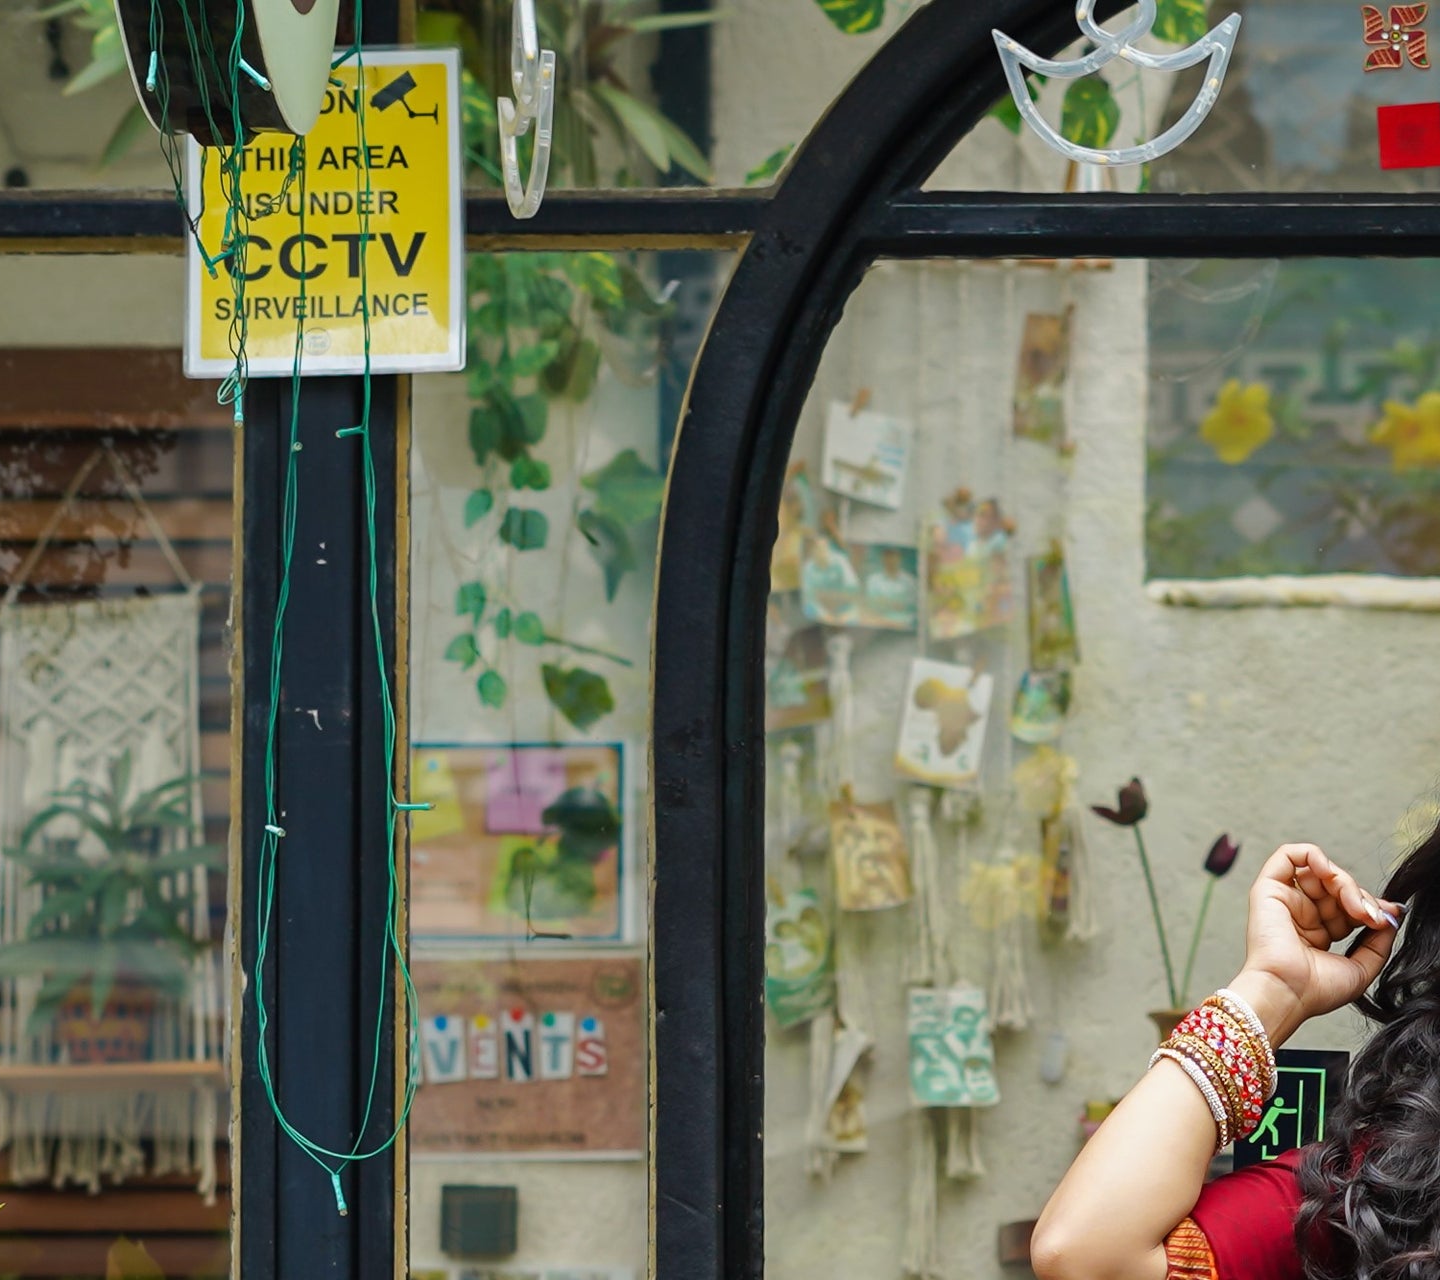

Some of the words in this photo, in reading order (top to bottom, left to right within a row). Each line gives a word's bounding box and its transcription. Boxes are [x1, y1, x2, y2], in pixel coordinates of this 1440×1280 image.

[317, 145, 409, 171] AREA
[247, 193, 273, 217] IS
[286, 190, 400, 217] UNDER
[223, 231, 427, 282] CCTV
[214, 293, 429, 321] SURVEILLANCE
[428, 1028, 606, 1082] VENTS
